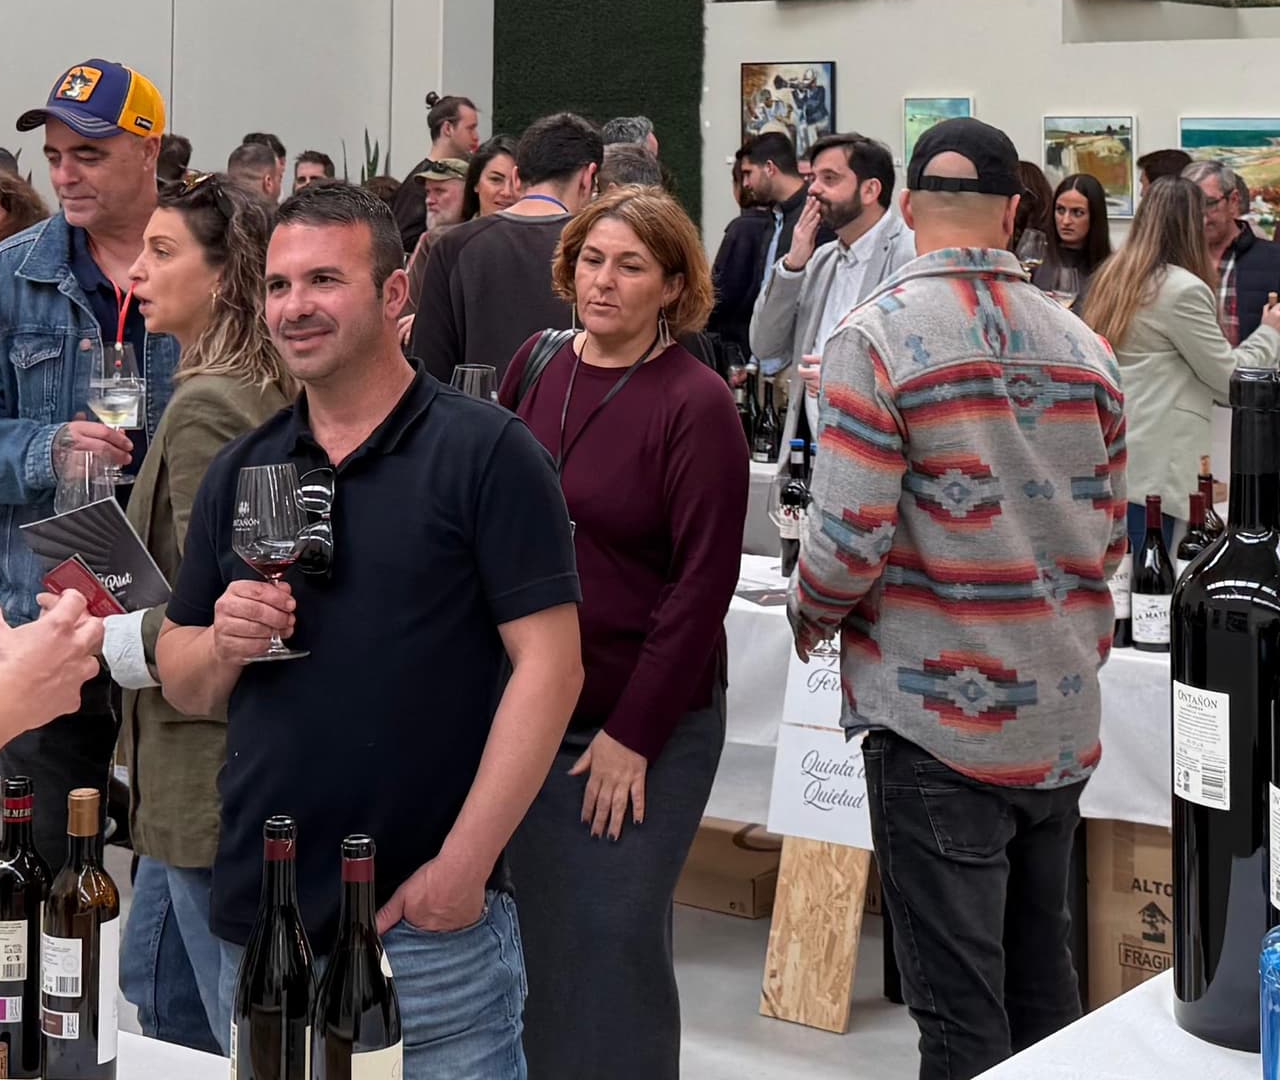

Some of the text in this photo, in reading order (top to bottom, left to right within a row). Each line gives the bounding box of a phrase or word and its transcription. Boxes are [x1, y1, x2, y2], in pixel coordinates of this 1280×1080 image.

[806, 668, 841, 694] Fer
[800, 749, 856, 782] Quinta
[802, 780, 866, 812] Quietud
